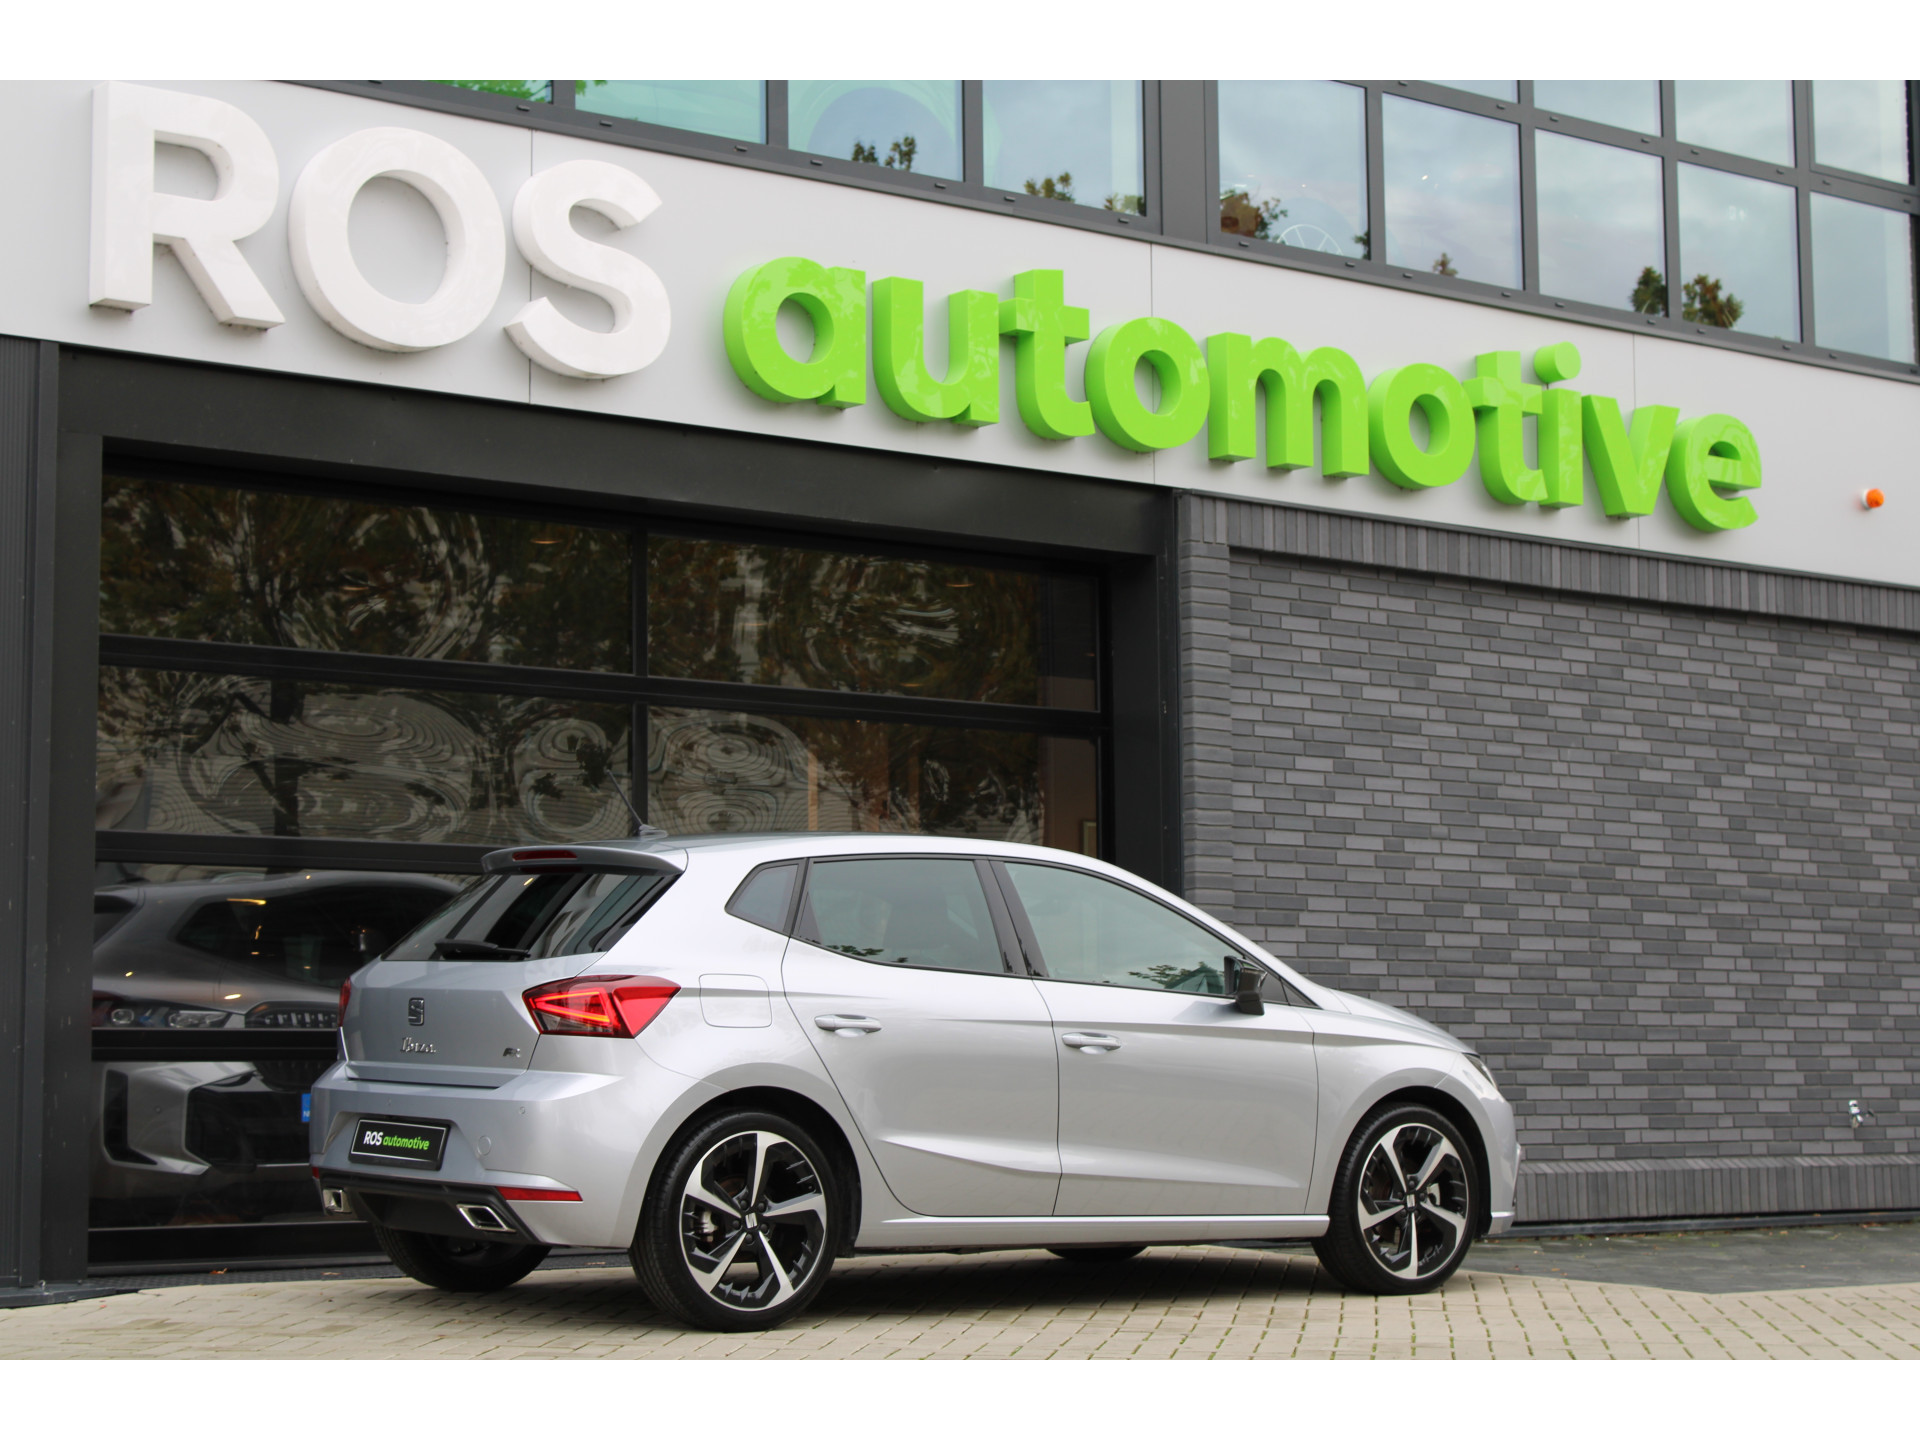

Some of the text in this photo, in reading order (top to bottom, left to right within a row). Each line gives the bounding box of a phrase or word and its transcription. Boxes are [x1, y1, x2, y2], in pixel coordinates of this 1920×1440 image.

[89, 81, 1762, 532] ROS automotive
[363, 1131, 430, 1151] ROS automotive
